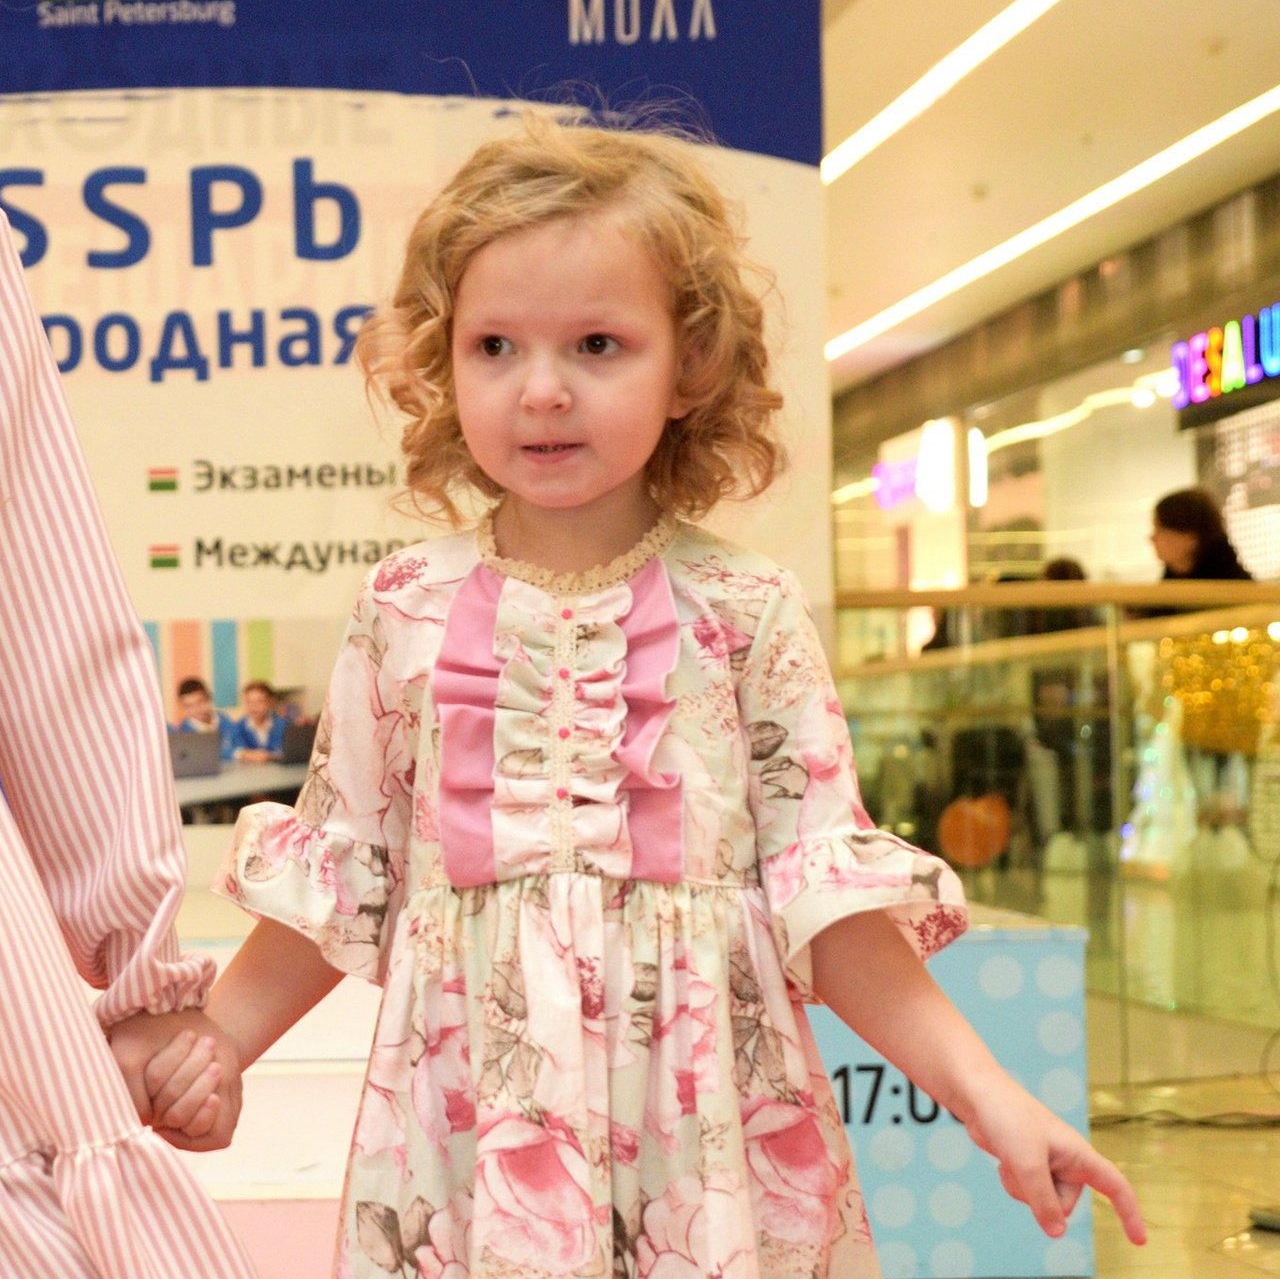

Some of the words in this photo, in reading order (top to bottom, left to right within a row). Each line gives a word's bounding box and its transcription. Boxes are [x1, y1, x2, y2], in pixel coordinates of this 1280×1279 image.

[37, 1, 98, 27] Saint
[192, 459, 397, 491] Экзамены
[194, 536, 428, 574] Междуна
[833, 1063, 964, 1125] 17:0
